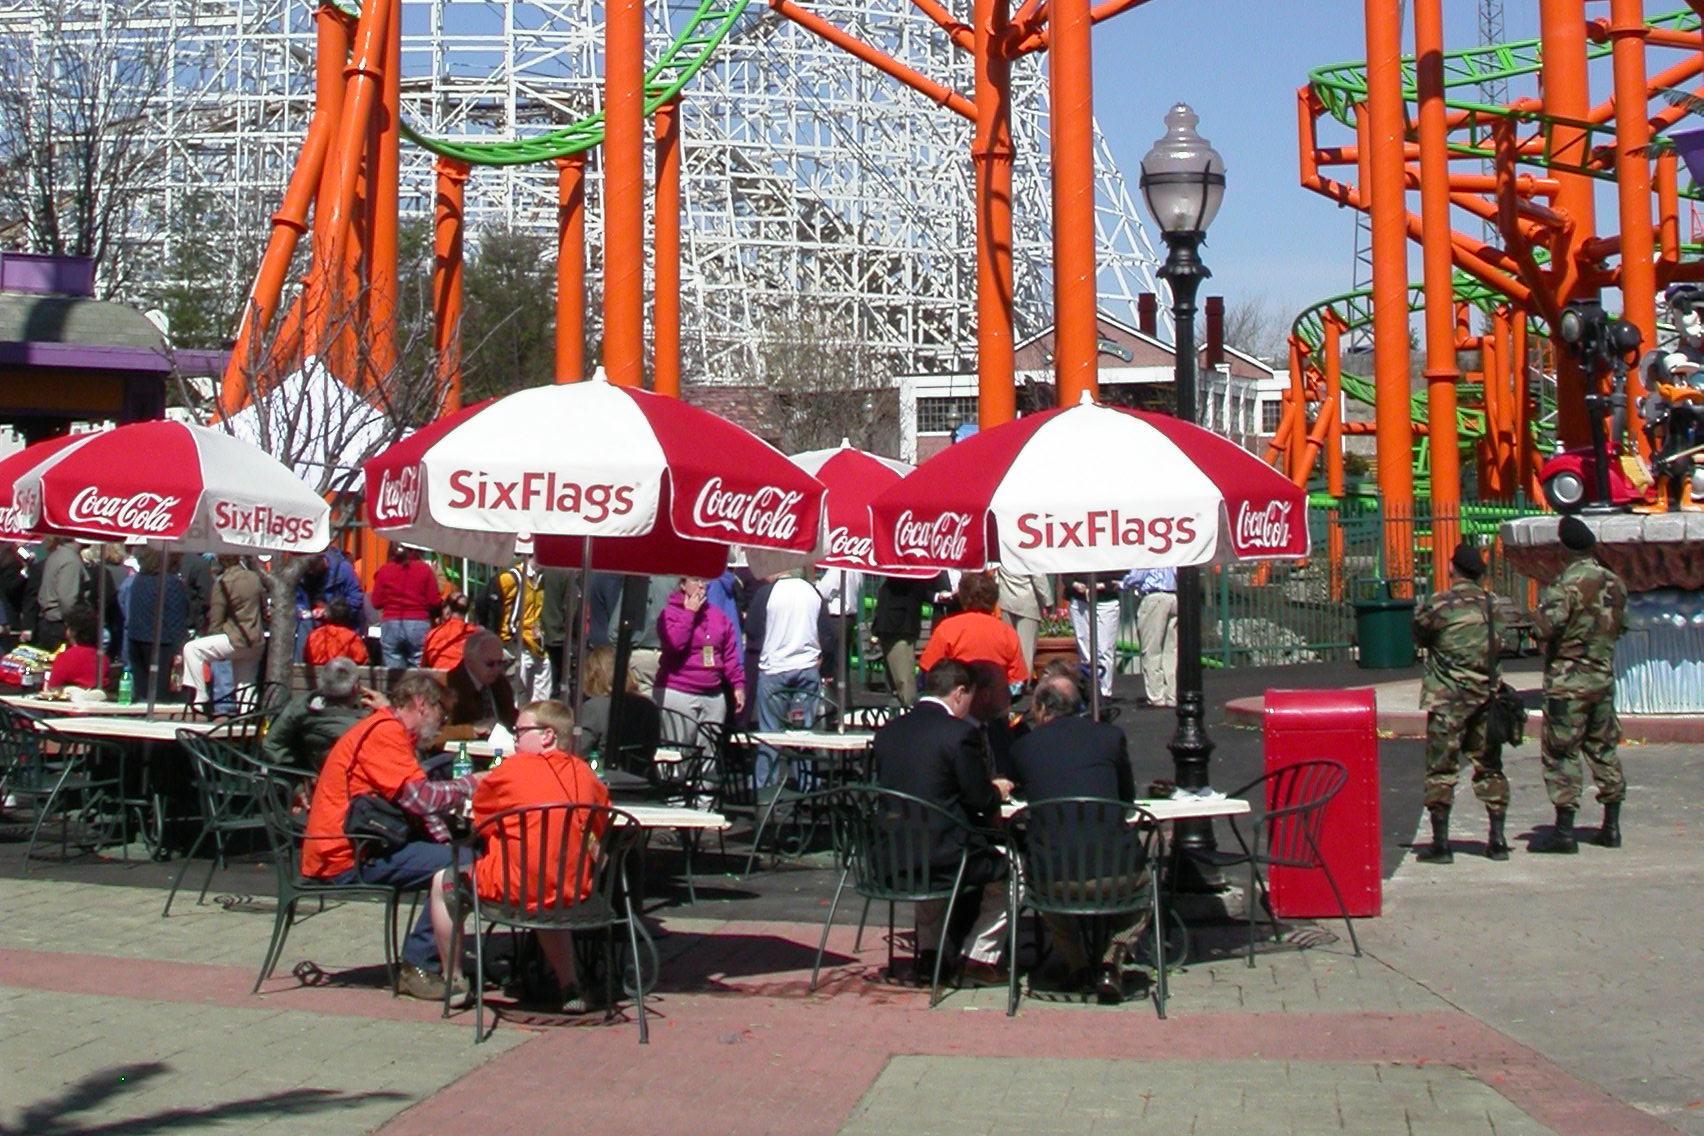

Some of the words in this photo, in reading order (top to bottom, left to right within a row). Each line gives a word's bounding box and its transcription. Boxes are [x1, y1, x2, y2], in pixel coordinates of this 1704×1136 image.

[68, 486, 181, 532] Coca-Cola
[448, 470, 635, 523] SixFlags
[693, 477, 804, 540] Coca-Cola
[895, 510, 973, 561] Coca-Cola
[1017, 509, 1197, 554] SixFlags
